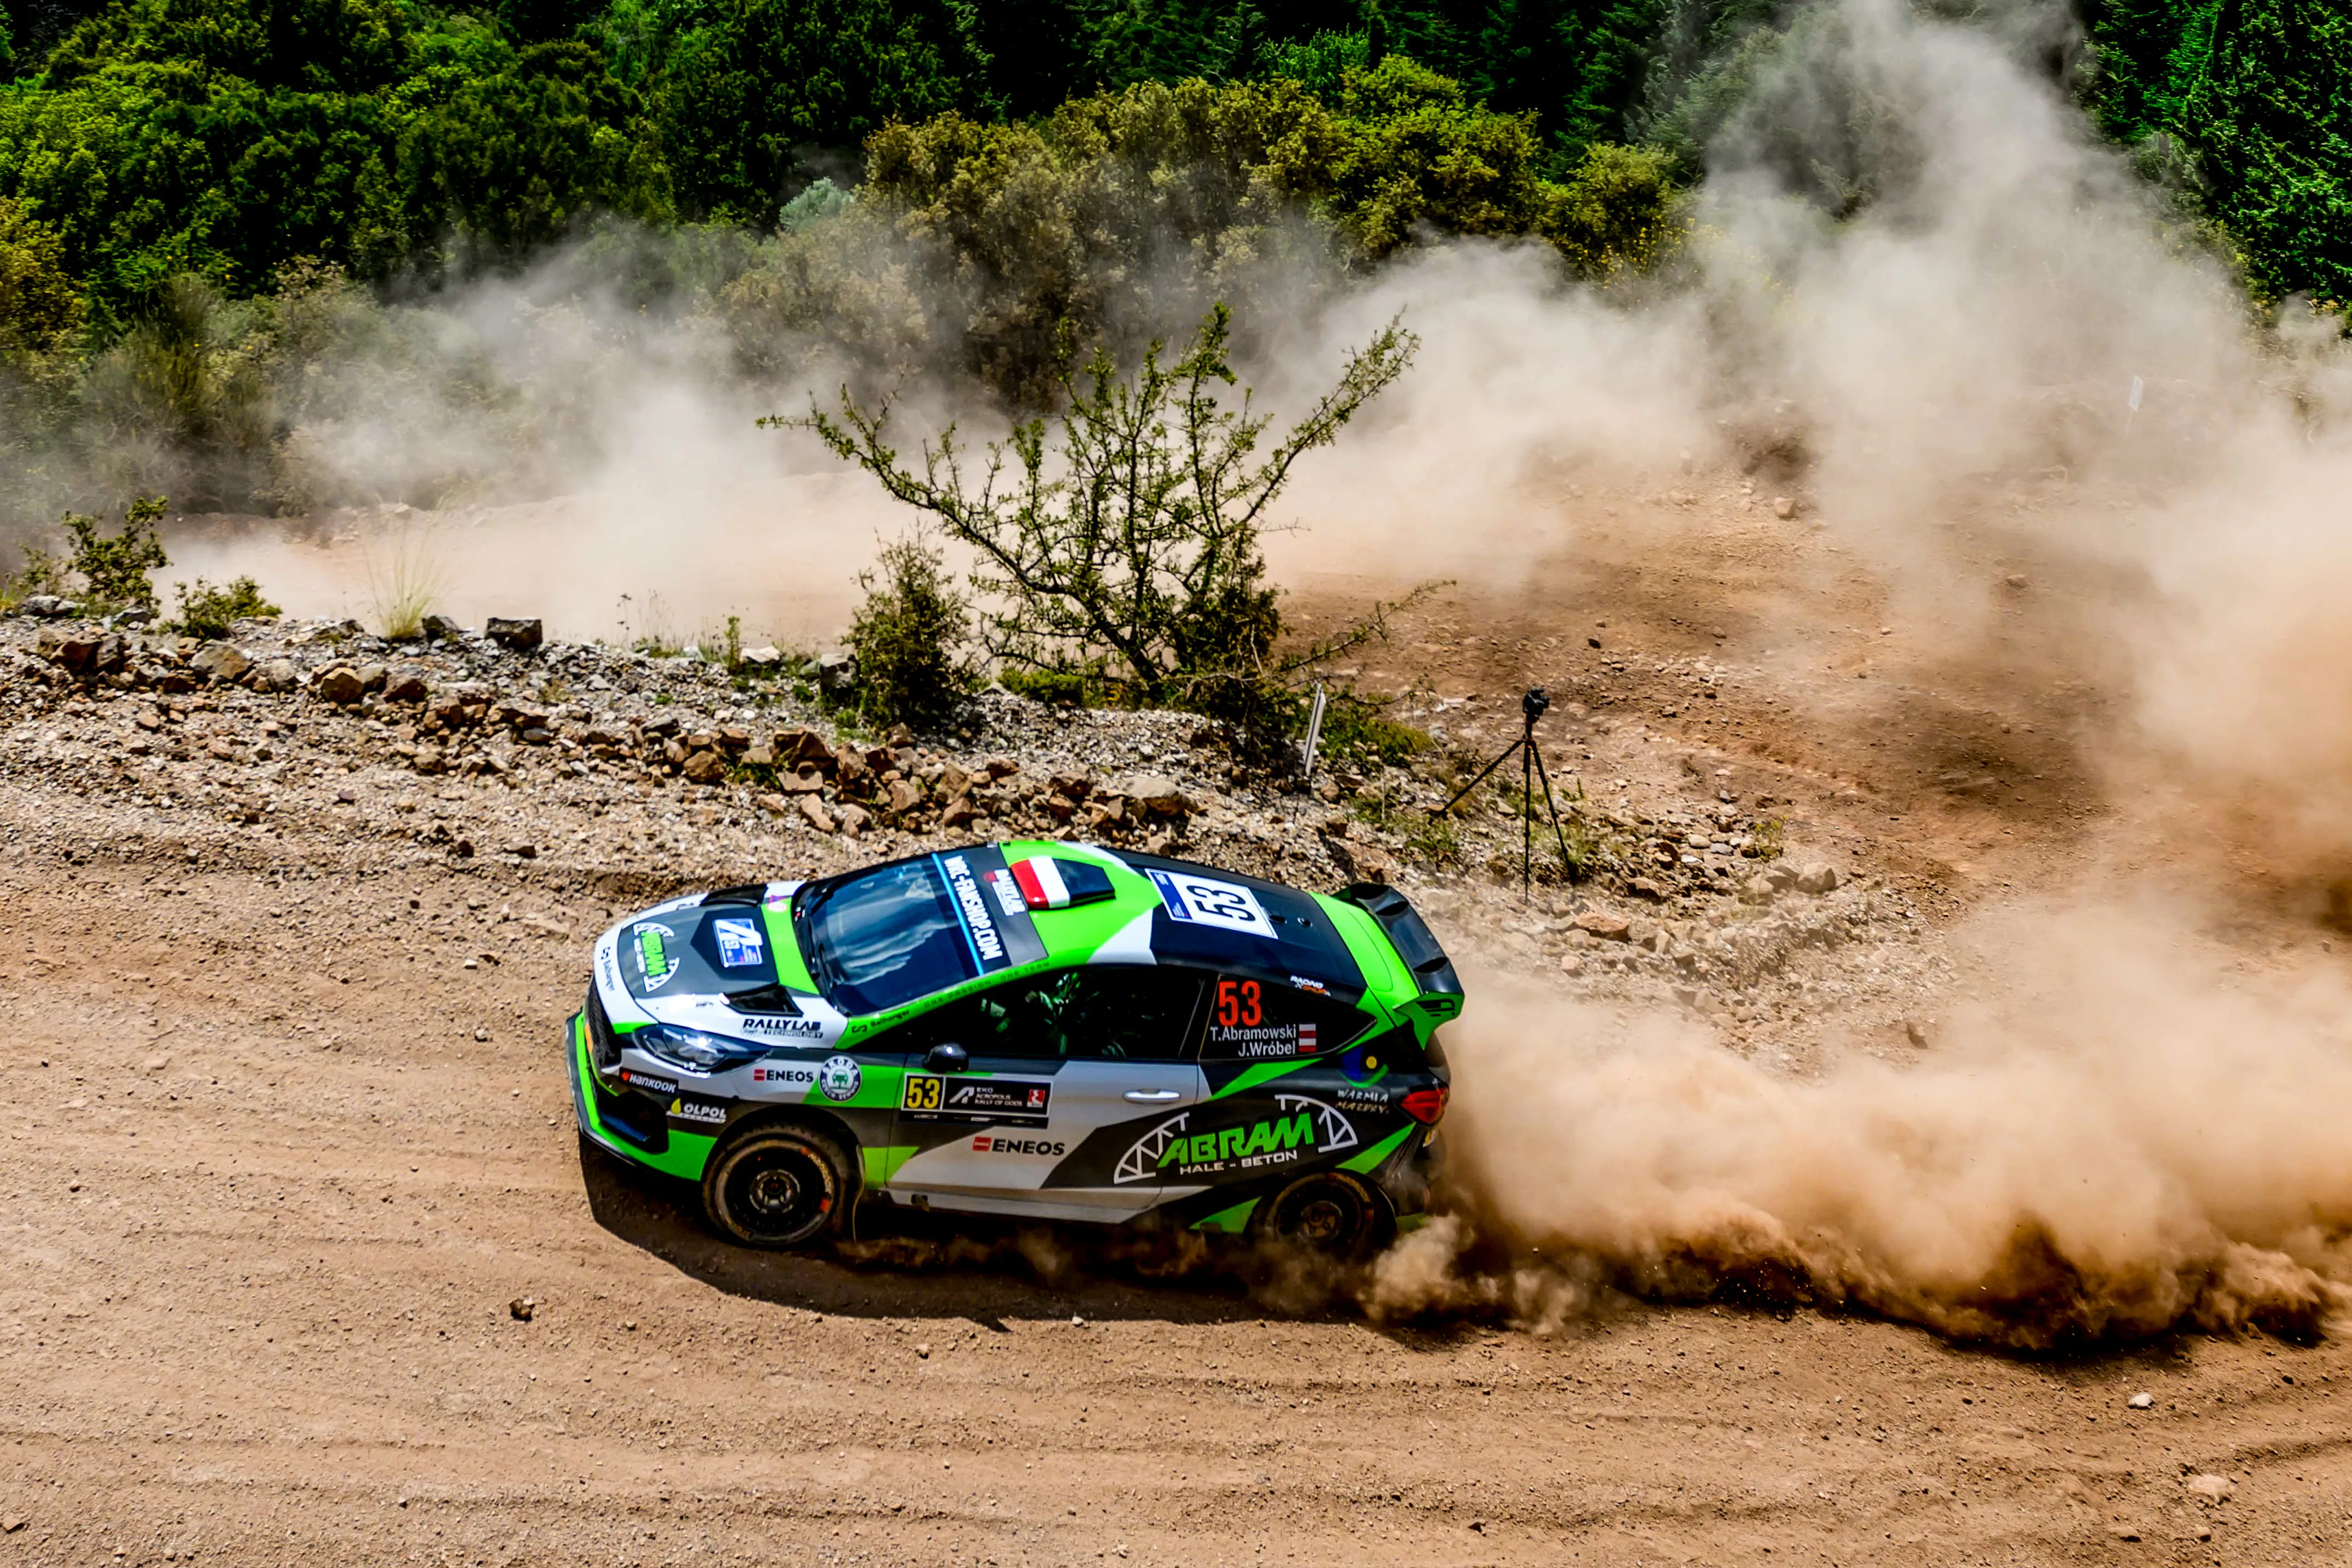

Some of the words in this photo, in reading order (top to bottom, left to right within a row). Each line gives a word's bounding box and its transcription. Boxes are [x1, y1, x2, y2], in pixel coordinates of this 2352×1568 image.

[944, 855, 1002, 960] WRC-FANSHOP.COM
[1186, 885, 1256, 921] 53
[1218, 981, 1262, 1027] 53
[743, 1019, 821, 1031] RALLYLAB
[1210, 1023, 1296, 1042] T.Abramowski
[1238, 1040, 1296, 1057] J.Wróbel
[766, 1070, 814, 1082] ENEOS
[907, 1078, 940, 1109] 53
[1338, 1088, 1389, 1103] WARMIA
[684, 1102, 727, 1119] OLPOL
[992, 1138, 1065, 1156] ENEOS
[1156, 1112, 1315, 1168] ABRAM
[1180, 1162, 1225, 1175] HALE
[1241, 1150, 1298, 1168] BETON
